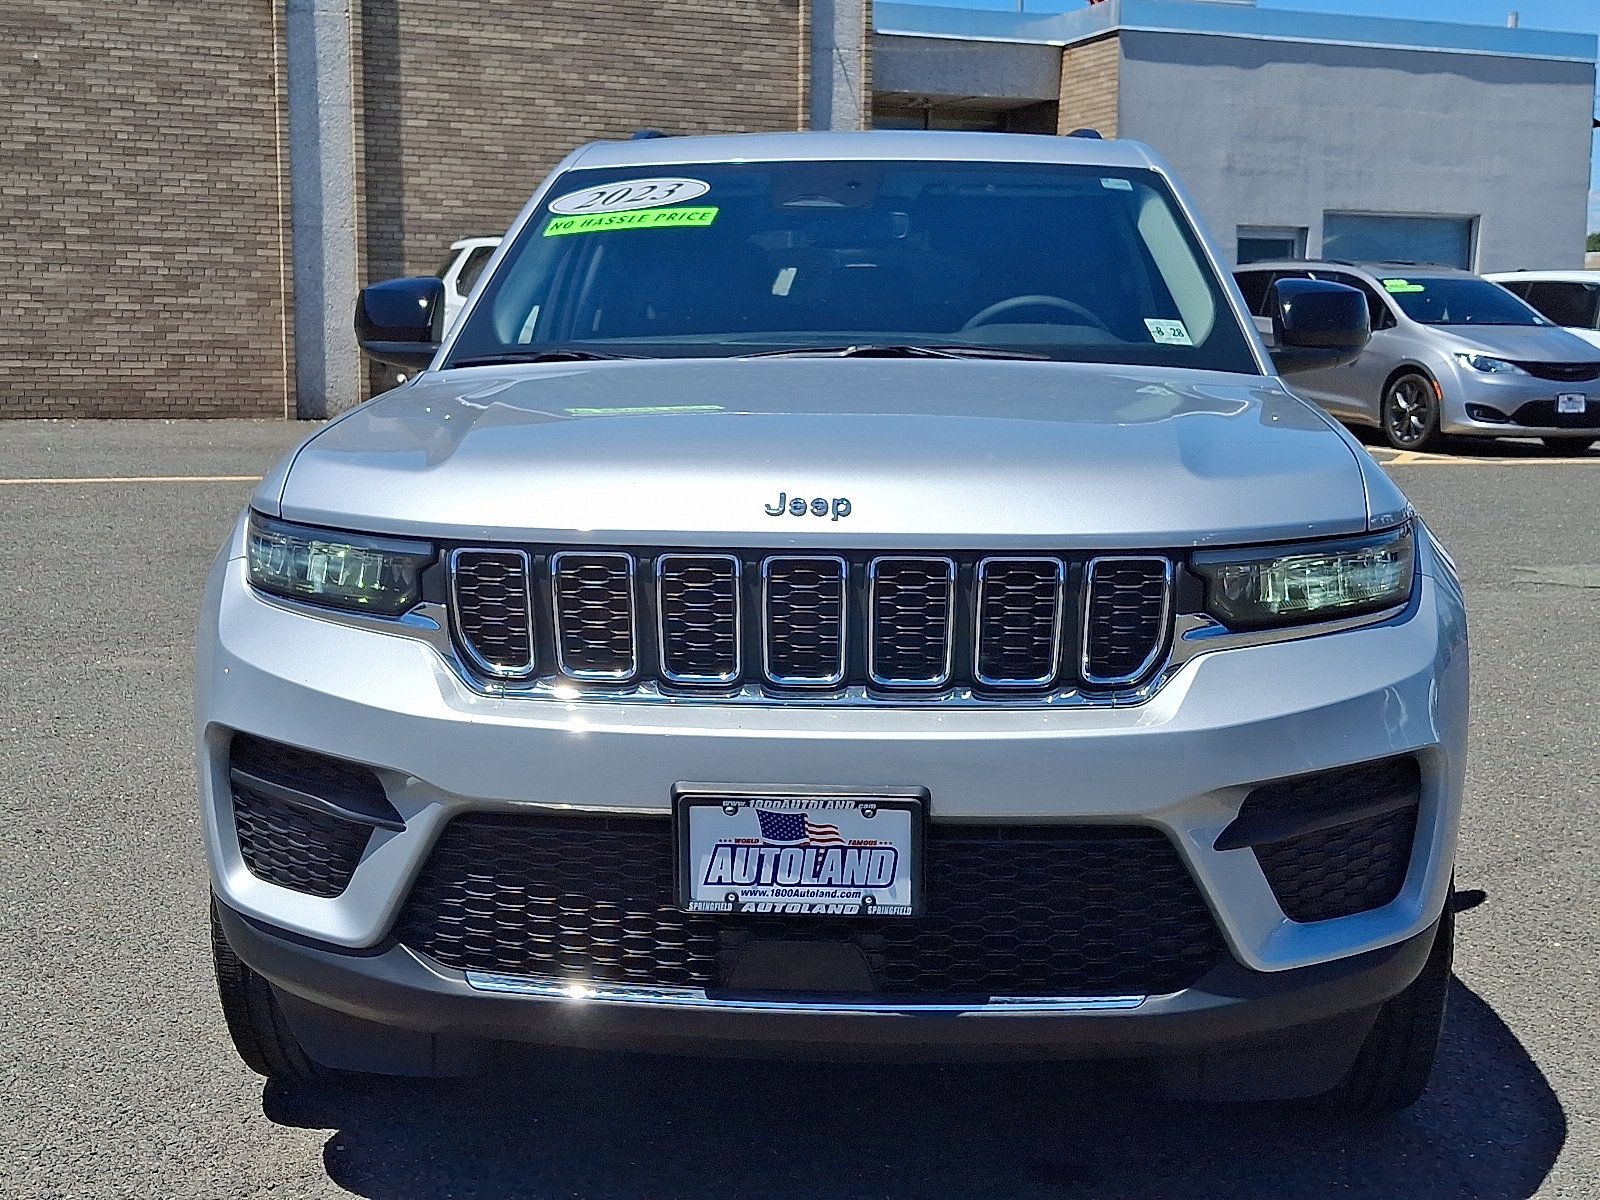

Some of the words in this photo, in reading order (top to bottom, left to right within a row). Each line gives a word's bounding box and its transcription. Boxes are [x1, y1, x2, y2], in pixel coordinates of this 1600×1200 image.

[573, 183, 684, 210] 2023
[550, 221, 575, 230] NO
[580, 214, 651, 227] HASSLE
[654, 212, 712, 222] PRICE
[1169, 327, 1184, 337] 28
[764, 492, 852, 522] Jeep
[705, 845, 897, 887] AUTOLAND
[740, 888, 862, 899] www.1800Autoland.com
[688, 901, 733, 911] SPRINGFIELD
[741, 903, 860, 915] AUTOLAND
[867, 905, 912, 916] SPRINGFIELD
